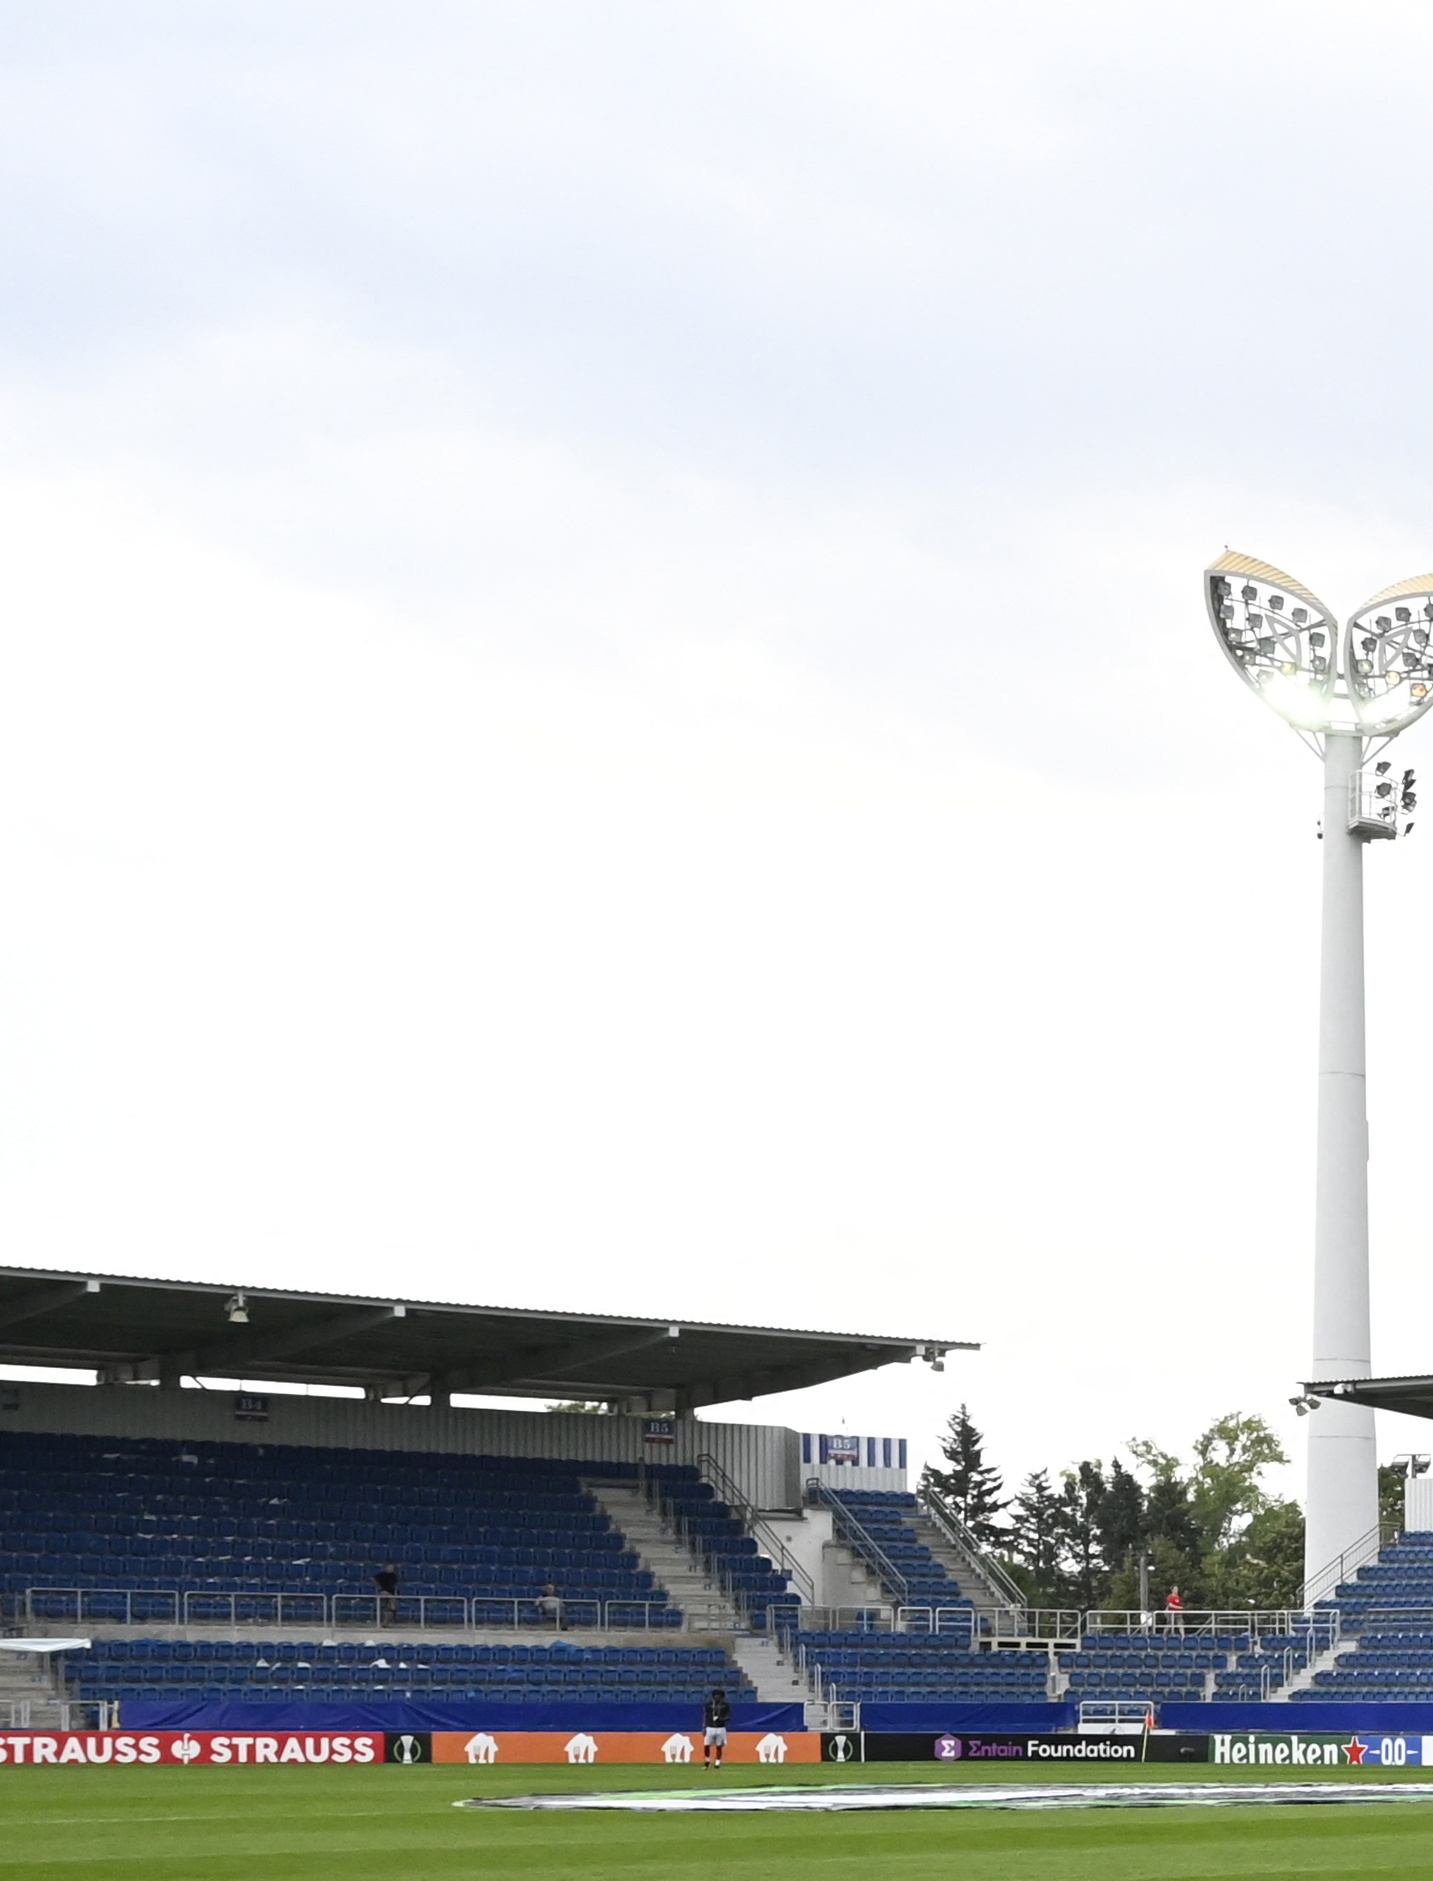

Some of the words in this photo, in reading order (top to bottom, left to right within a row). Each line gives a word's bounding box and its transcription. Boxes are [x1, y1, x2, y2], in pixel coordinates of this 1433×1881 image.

[209, 1736, 375, 1763] STRAUSS
[1027, 1740, 1136, 1758] Foundation
[1213, 1734, 1339, 1765] Heineken
